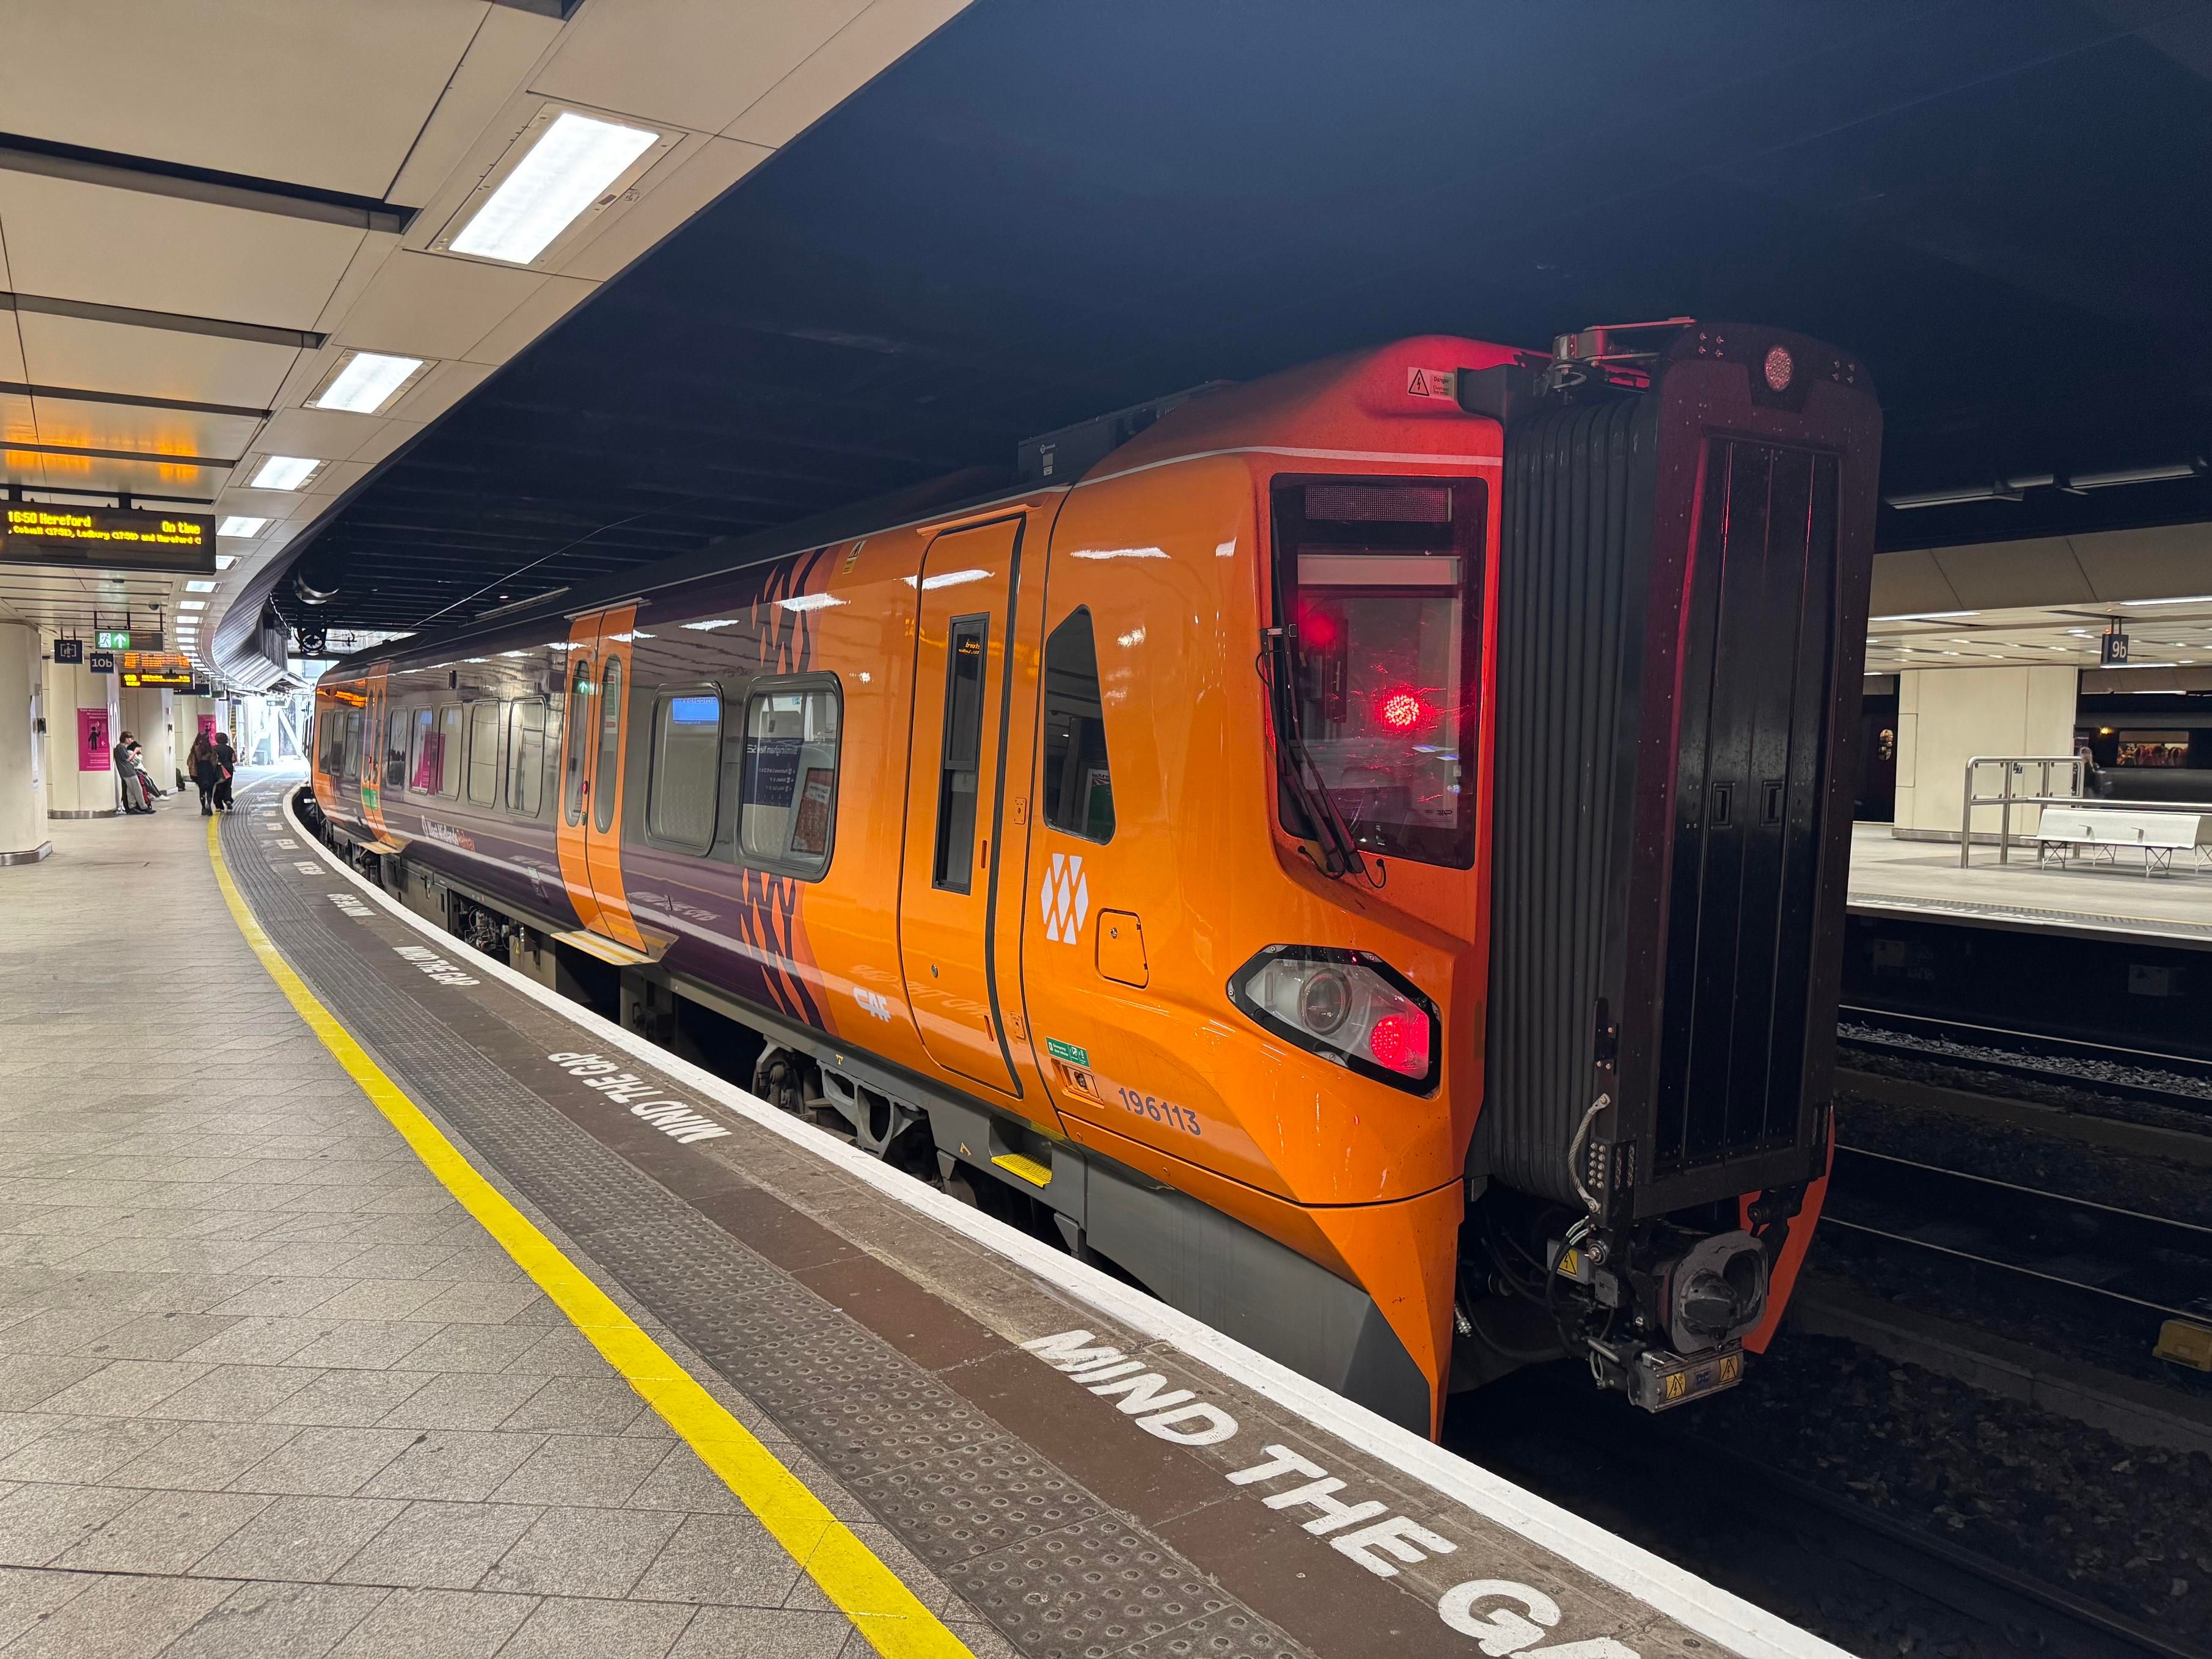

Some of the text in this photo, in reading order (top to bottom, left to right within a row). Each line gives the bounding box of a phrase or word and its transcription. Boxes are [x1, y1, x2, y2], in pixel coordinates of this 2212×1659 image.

[1434, 376, 1449, 384] Danger
[8, 511, 91, 527] 16:50 Hereford
[161, 520, 200, 535] On time
[141, 533, 156, 542] and
[2112, 640, 2126, 659] 9b
[92, 658, 112, 668] 10b
[392, 946, 481, 986] MIND THE GAP
[548, 1052, 733, 1144] MIND THE GAP
[1118, 1087, 1201, 1135] 196113
[1020, 1329, 1239, 1446] MIND
[1225, 1443, 1457, 1578] THE
